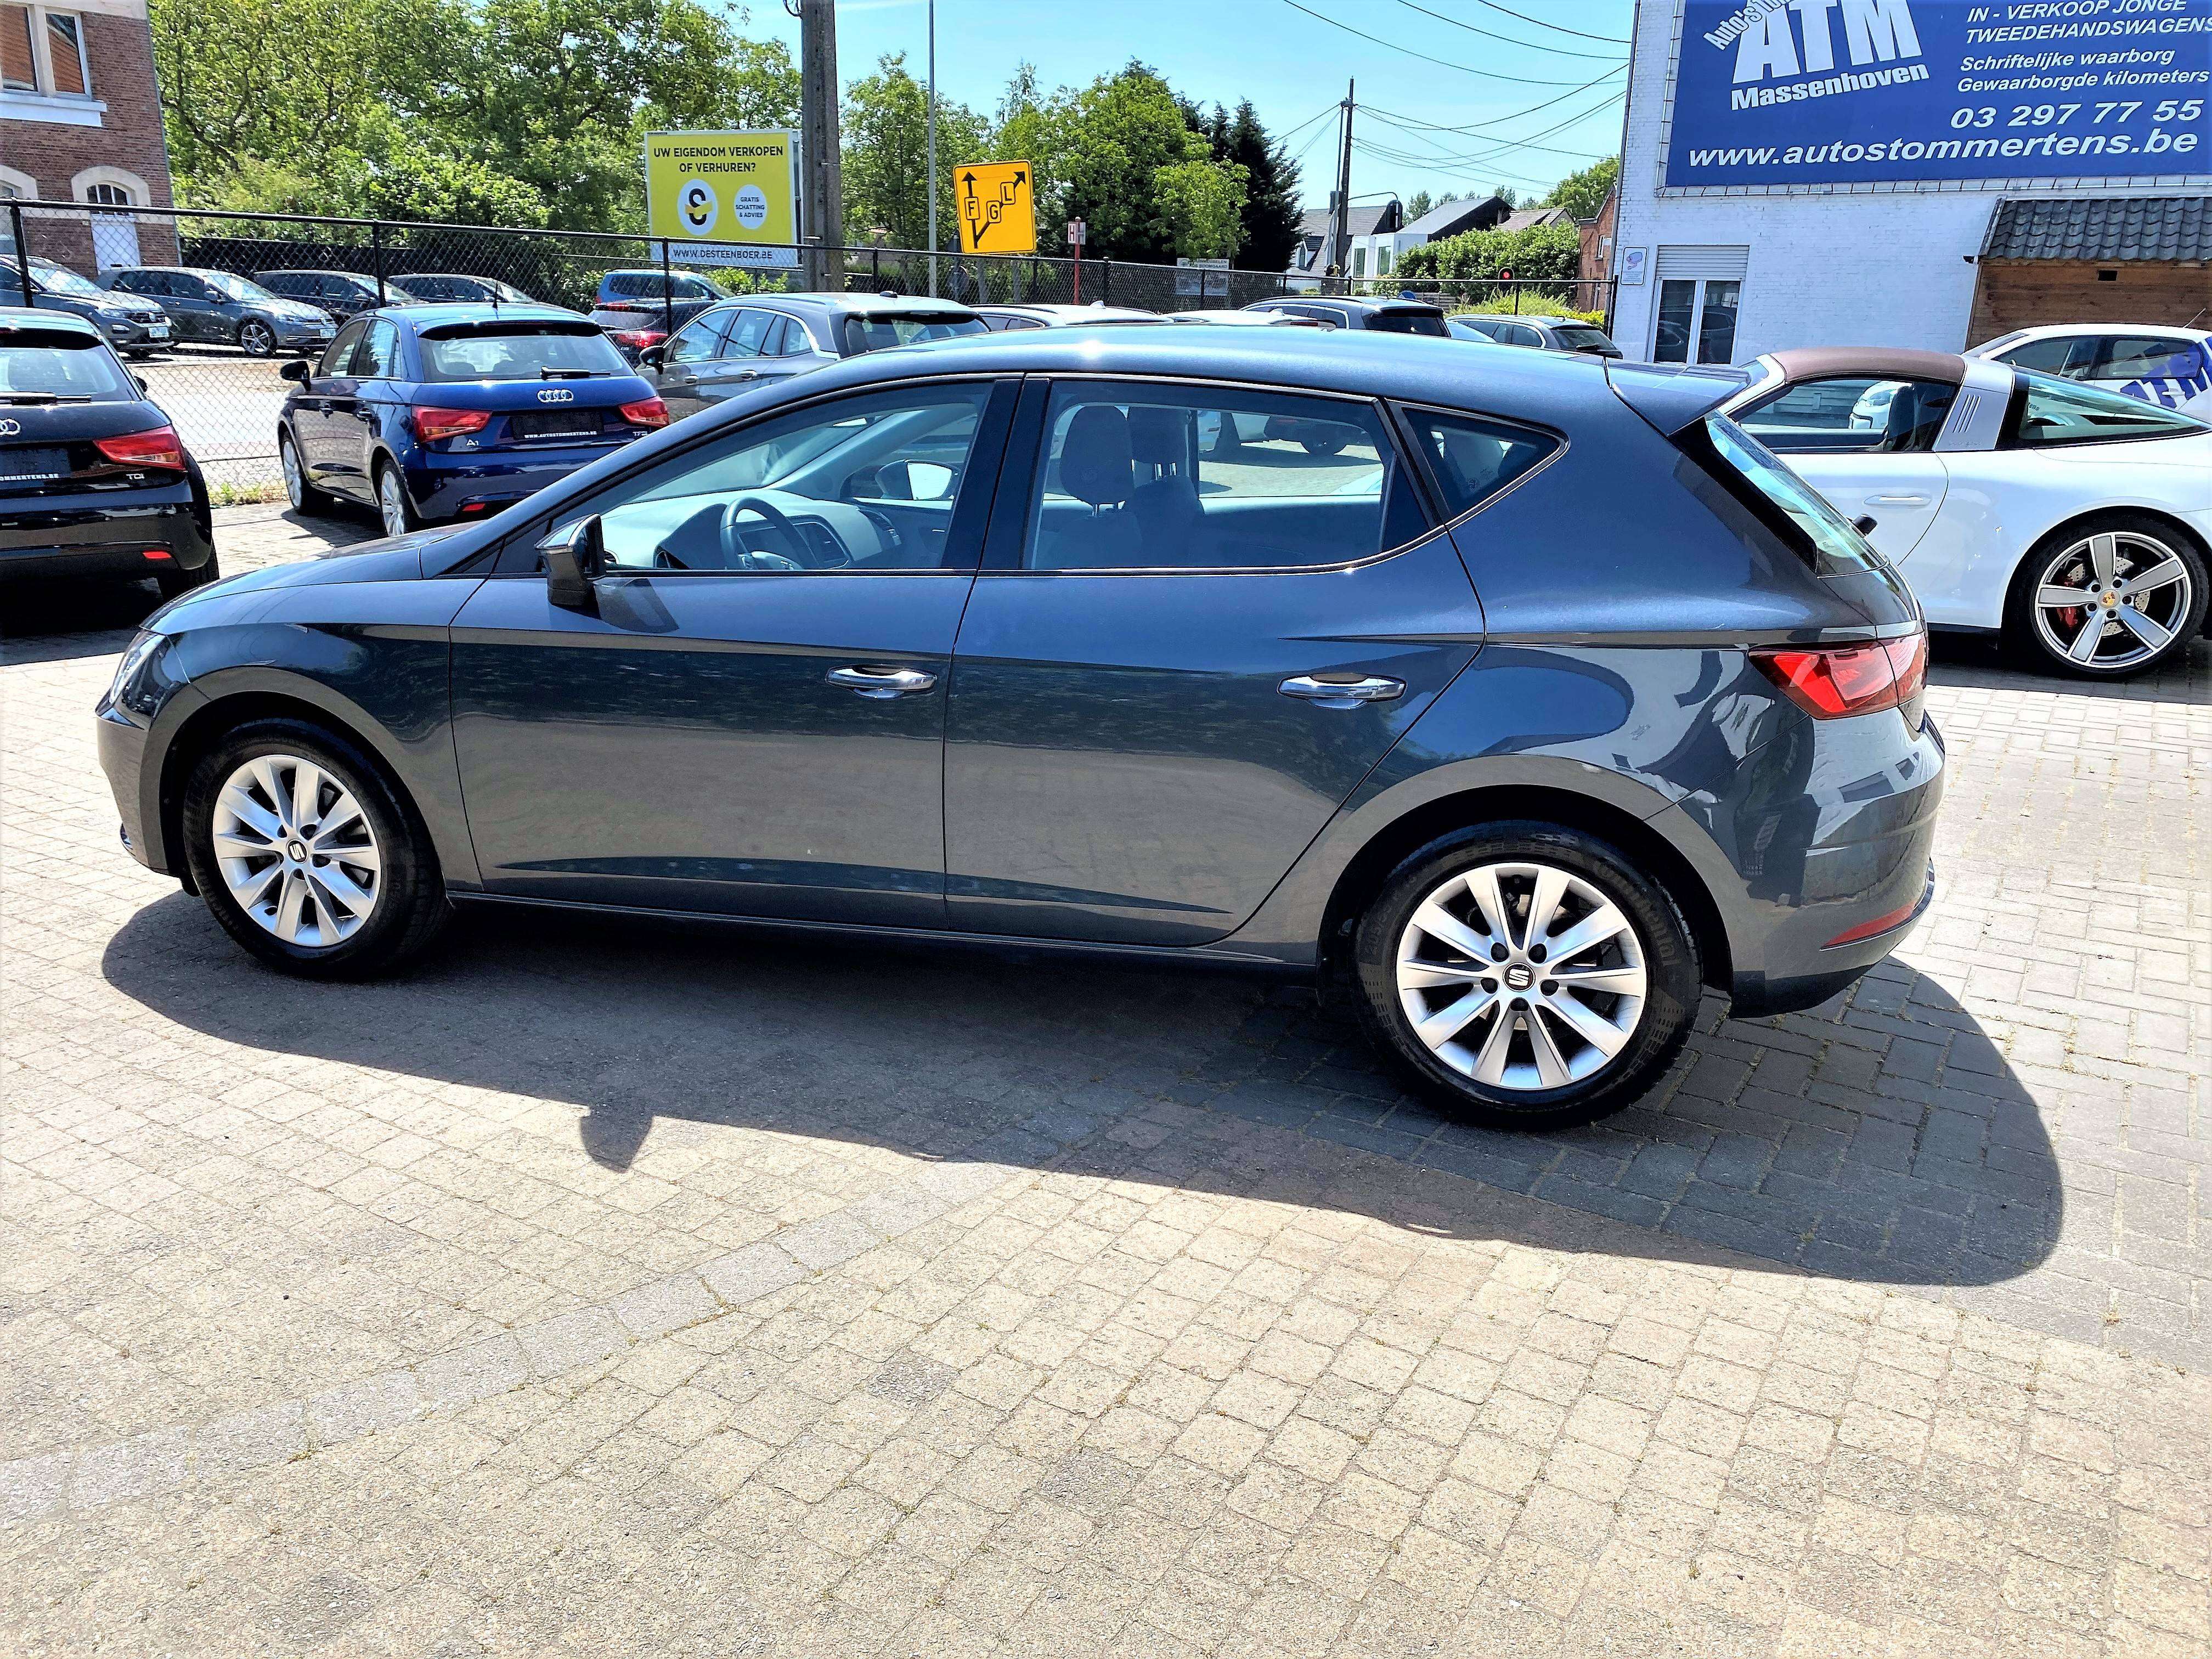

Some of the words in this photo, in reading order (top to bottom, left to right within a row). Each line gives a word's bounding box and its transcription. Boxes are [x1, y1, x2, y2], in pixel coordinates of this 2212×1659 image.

[1967, 7, 1990, 23] IN
[2007, 0, 2109, 21] VERKOOP
[2112, 0, 2187, 13] JONGE
[1703, 6, 1763, 50] Auto's
[1750, 0, 1794, 12] To
[1966, 16, 2212, 44] TWEEDEHANDSWAGENS
[1732, 0, 1922, 84] ATM
[1960, 52, 2074, 71] Schriftelijke
[2080, 48, 2176, 65] waarborg
[1731, 63, 1931, 111] Massenhoven
[1957, 72, 2098, 93] Gewaarborgde
[2103, 69, 2210, 86] kilometers
[1950, 106, 1997, 129] 03
[2007, 103, 2083, 127] 297
[2092, 100, 2143, 124] 77
[2152, 99, 2205, 122] 55
[654, 148, 670, 157] UW
[674, 147, 726, 157] EIGENDOM
[728, 146, 783, 156] VERKOPEN
[1689, 127, 2199, 166] www.autostommertens.be
[679, 163, 693, 172] OF
[695, 162, 756, 172] VERHUREN?
[1003, 185, 1013, 202] L
[968, 200, 976, 216] F
[989, 204, 998, 219] G
